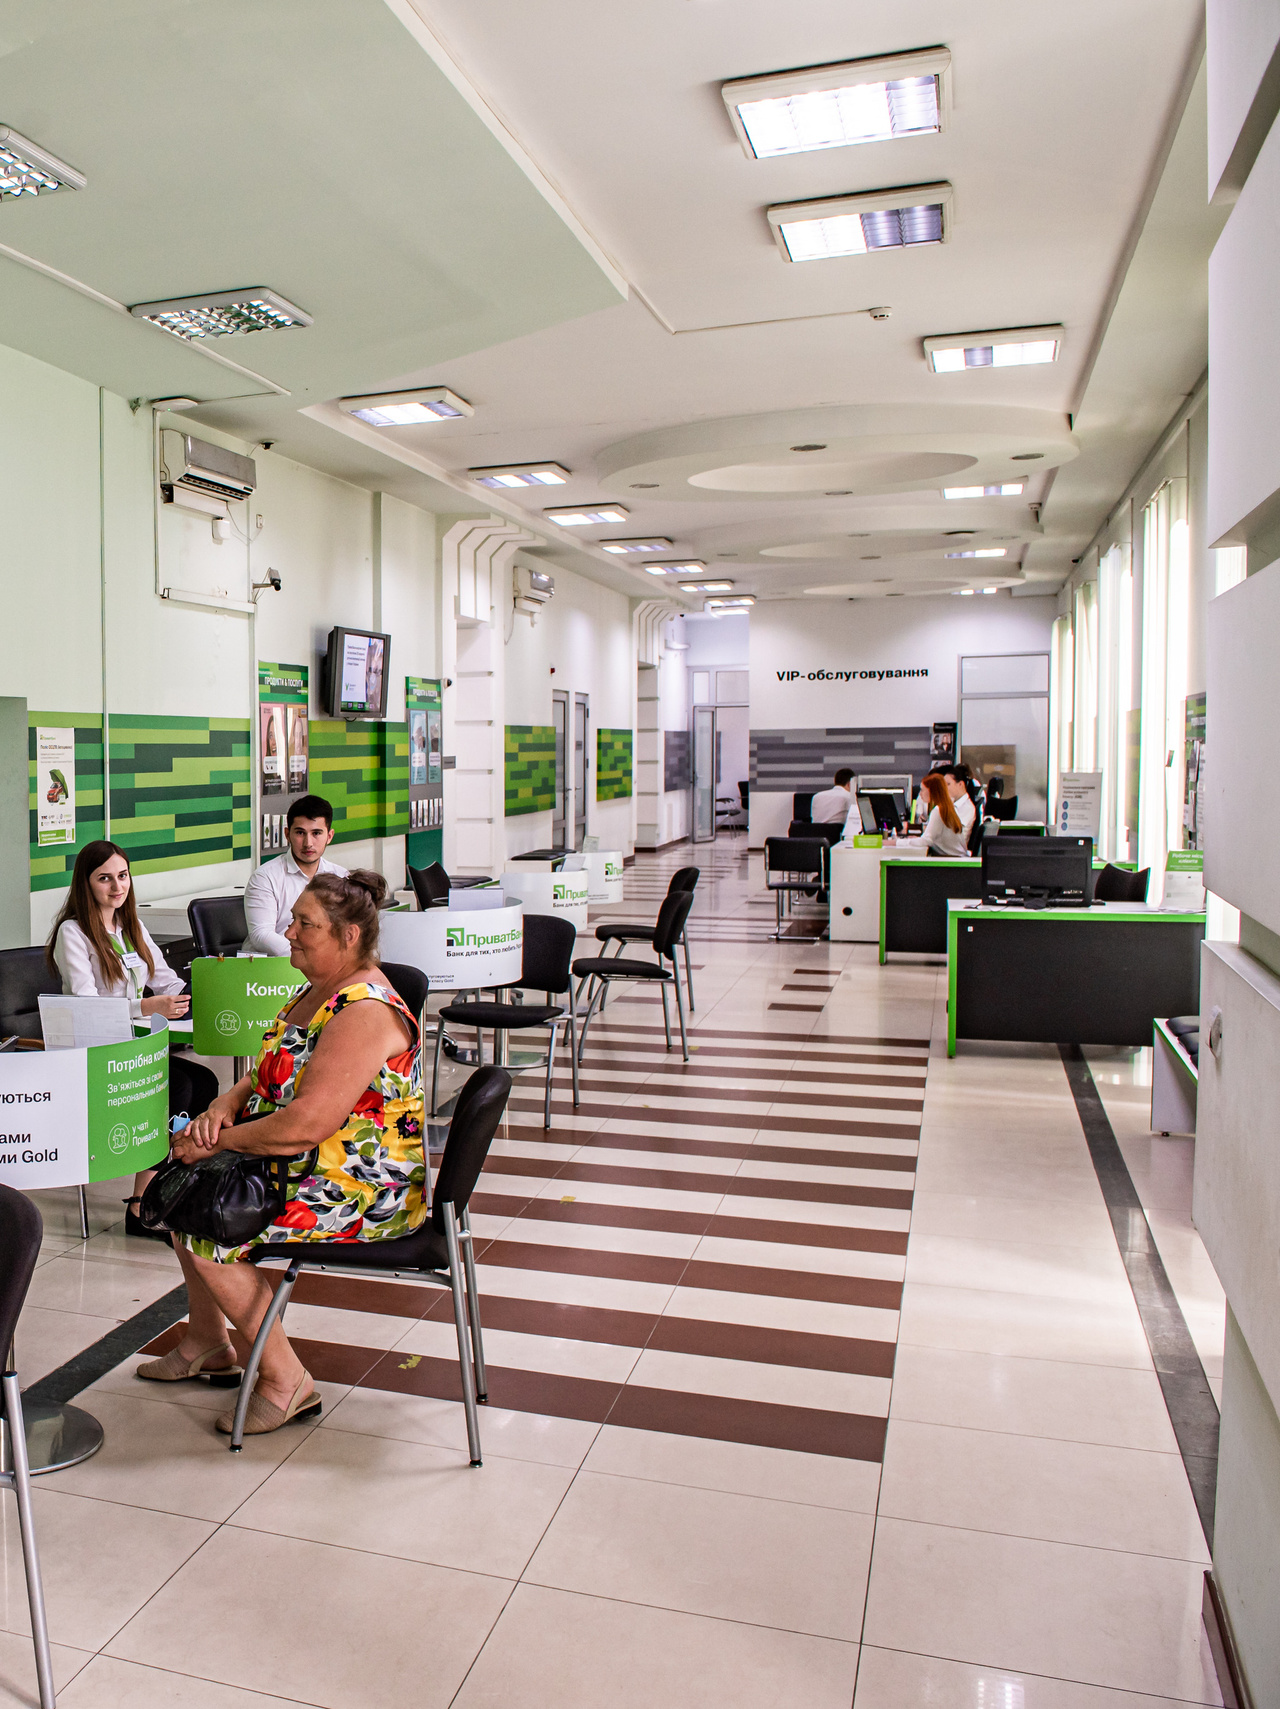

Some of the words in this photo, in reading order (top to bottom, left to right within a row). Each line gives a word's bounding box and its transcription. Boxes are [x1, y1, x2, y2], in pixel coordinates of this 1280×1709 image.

[776, 669, 929, 682] VIP-обслуговування
[247, 1020, 254, 1030] у
[256, 1020, 274, 1028] чат
[107, 1053, 153, 1074] Потрібна
[107, 1087, 155, 1108] персональним
[137, 1119, 149, 1131] чаті
[132, 1127, 159, 1147] Приват24
[22, 1148, 58, 1164] Gold
